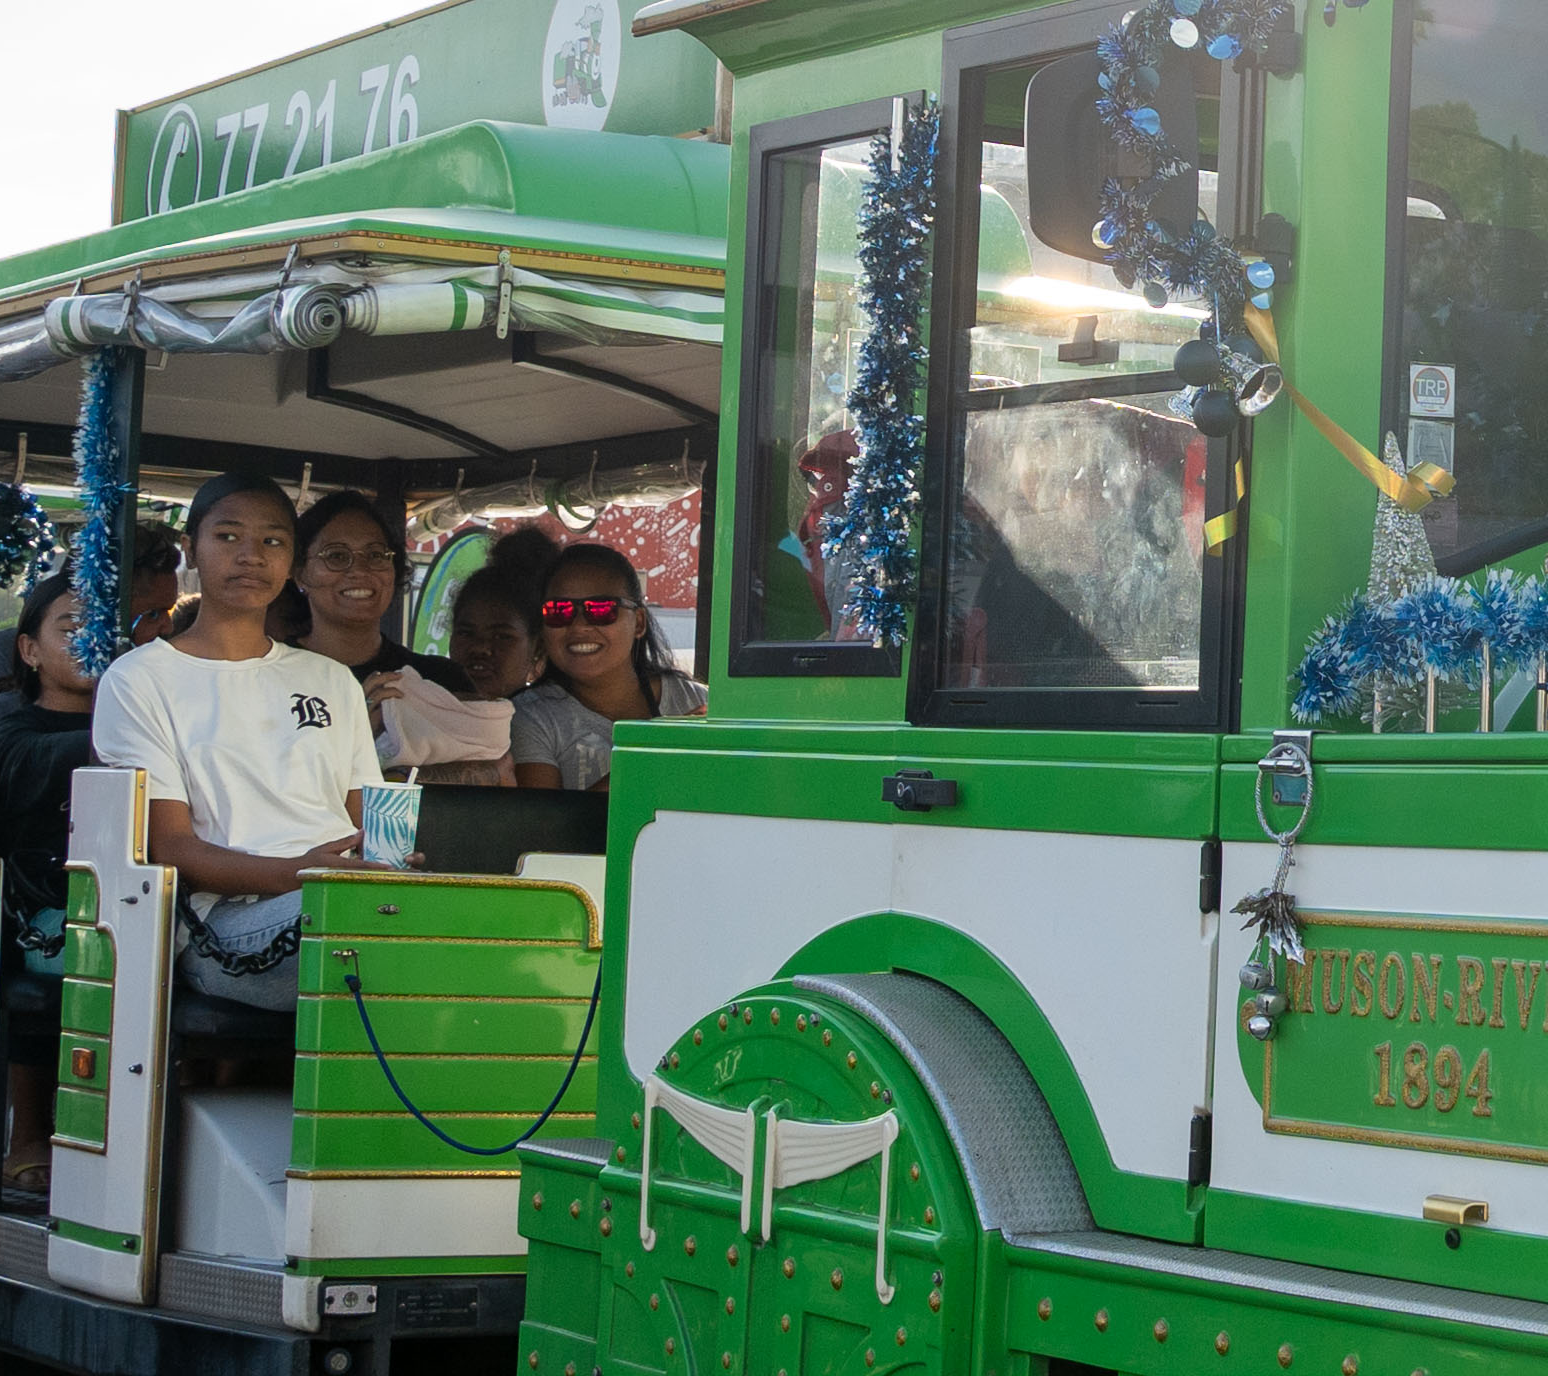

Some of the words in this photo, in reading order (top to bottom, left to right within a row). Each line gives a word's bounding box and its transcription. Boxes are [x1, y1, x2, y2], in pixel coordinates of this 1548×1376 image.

[215, 103, 270, 198] 77
[283, 78, 337, 179] 21
[360, 54, 420, 155] 76
[1416, 378, 1447, 397] TRP
[1372, 1042, 1493, 1117] 1894
